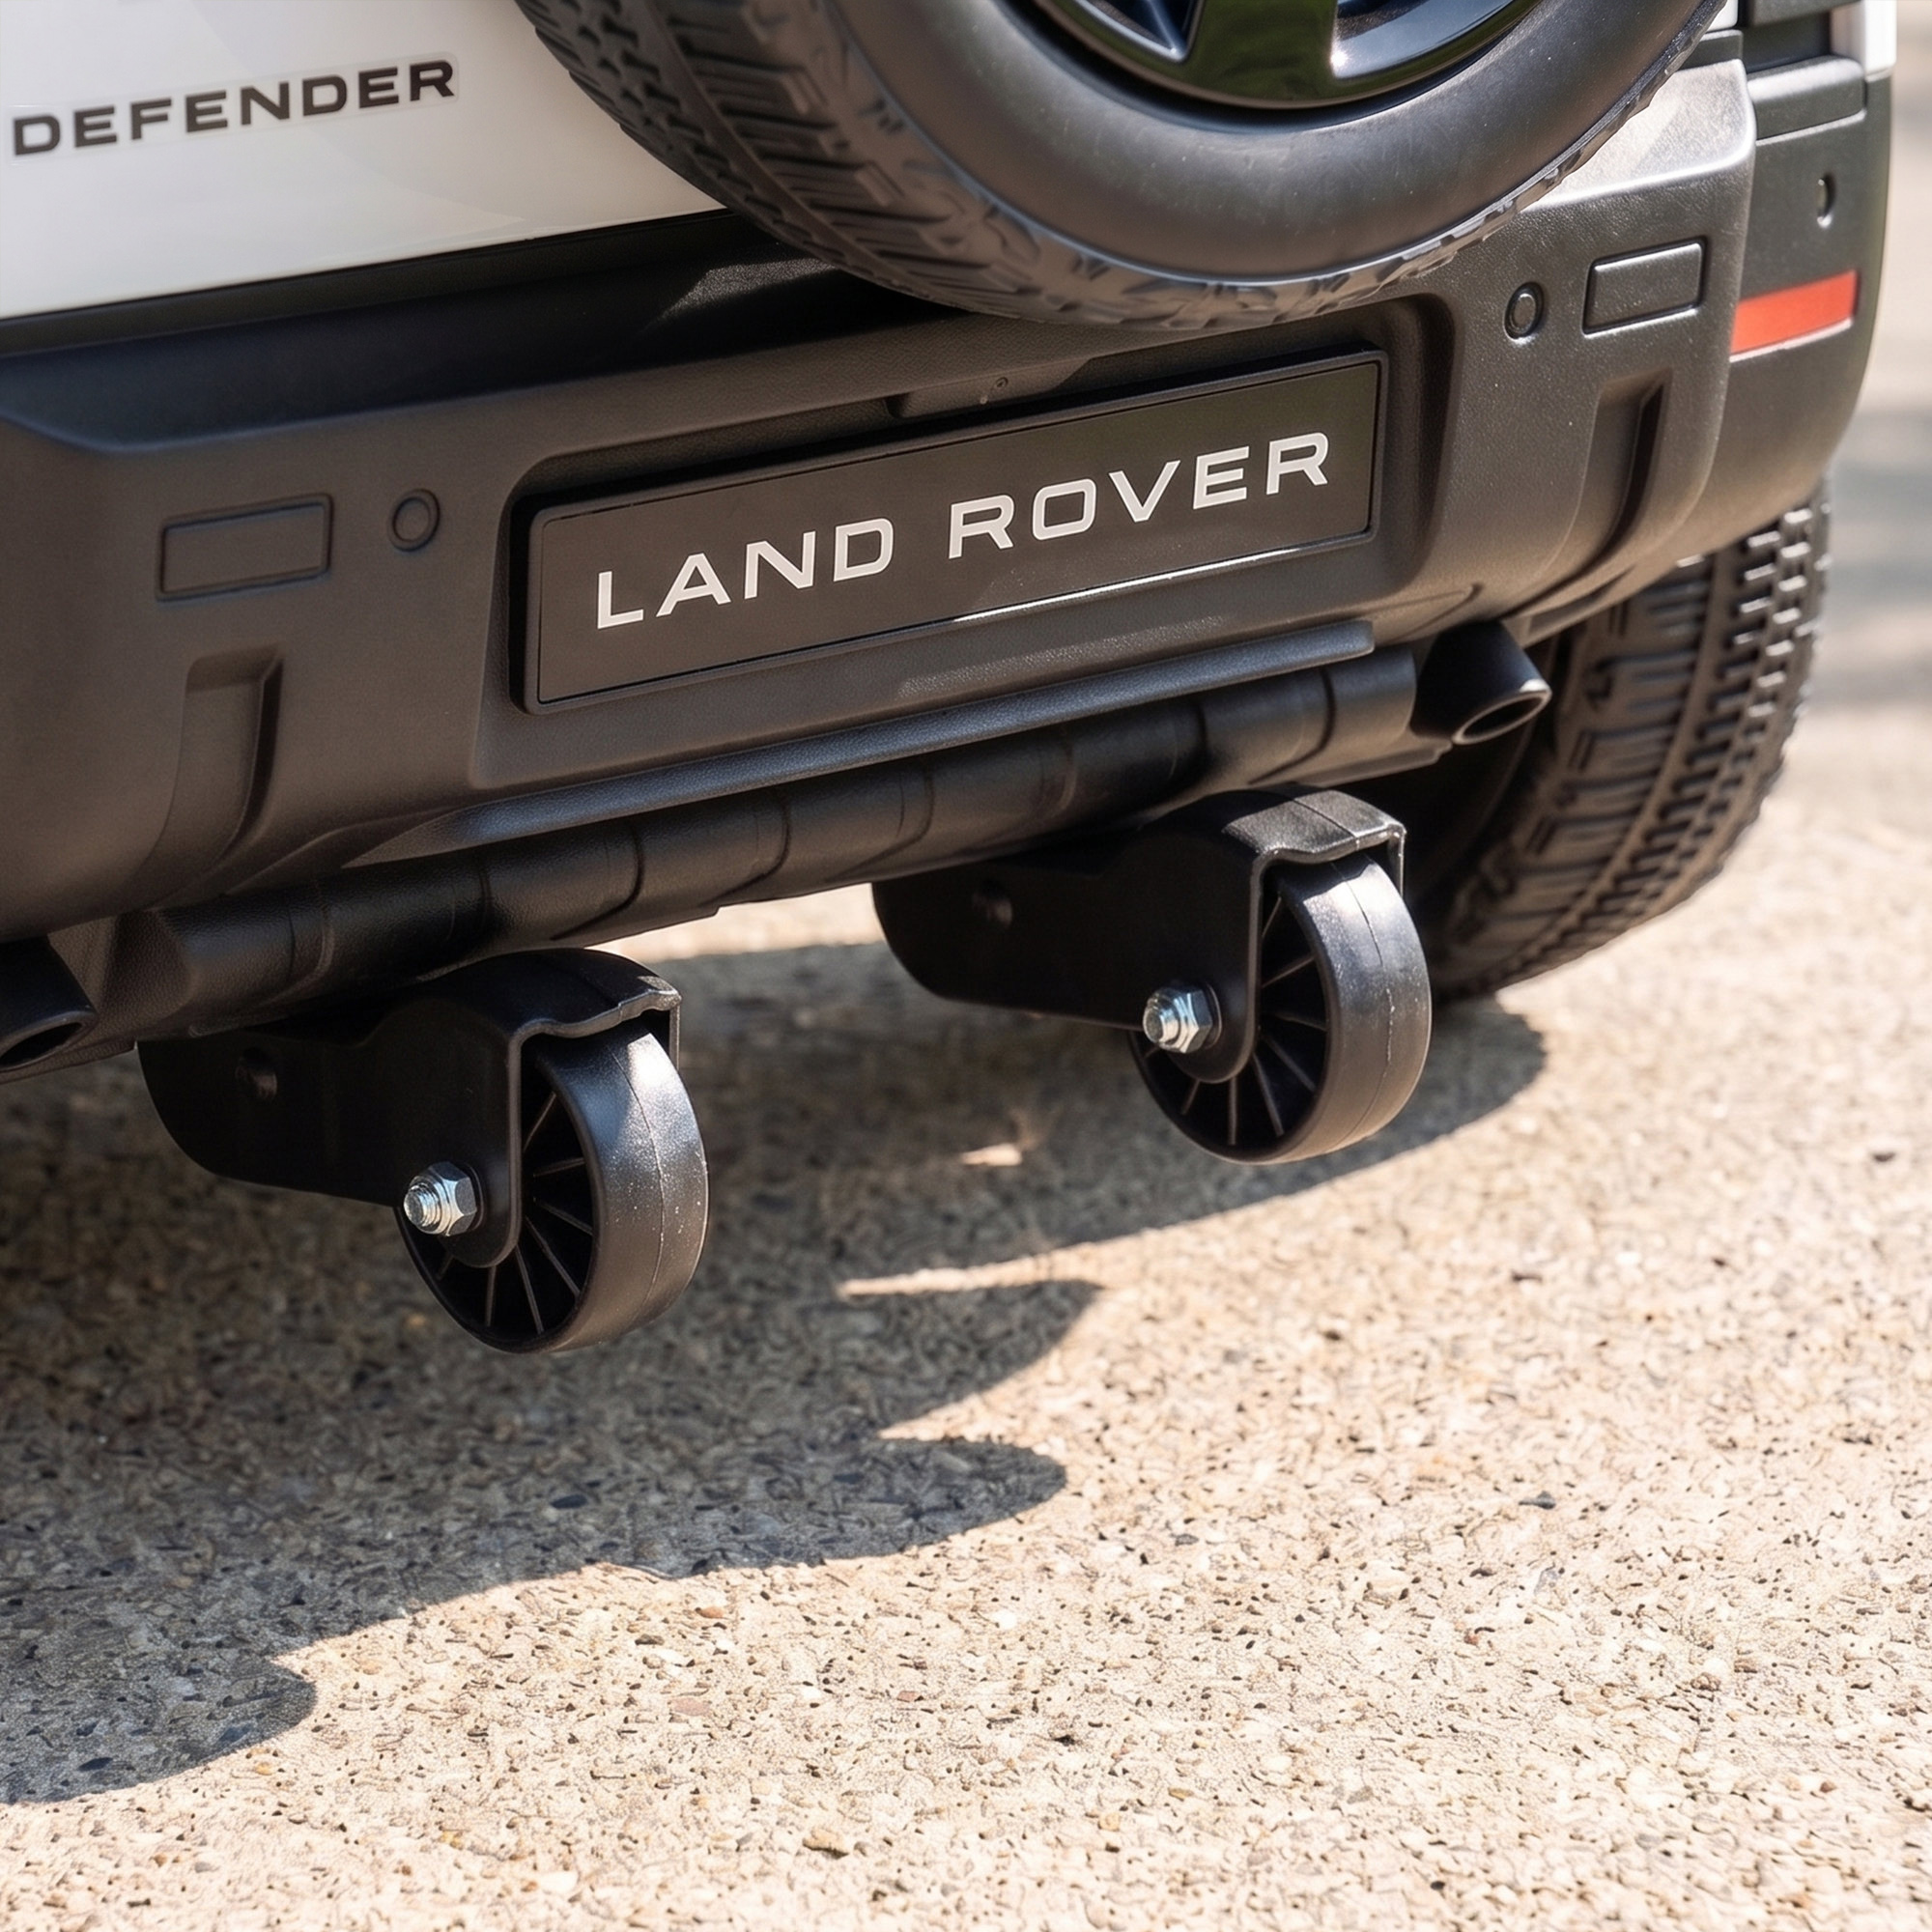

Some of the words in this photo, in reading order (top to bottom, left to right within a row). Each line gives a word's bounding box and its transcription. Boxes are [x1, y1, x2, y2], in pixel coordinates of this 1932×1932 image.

[13, 59, 456, 156] DEFENDER
[596, 516, 895, 630] LAND
[948, 431, 1329, 559] ROVER
